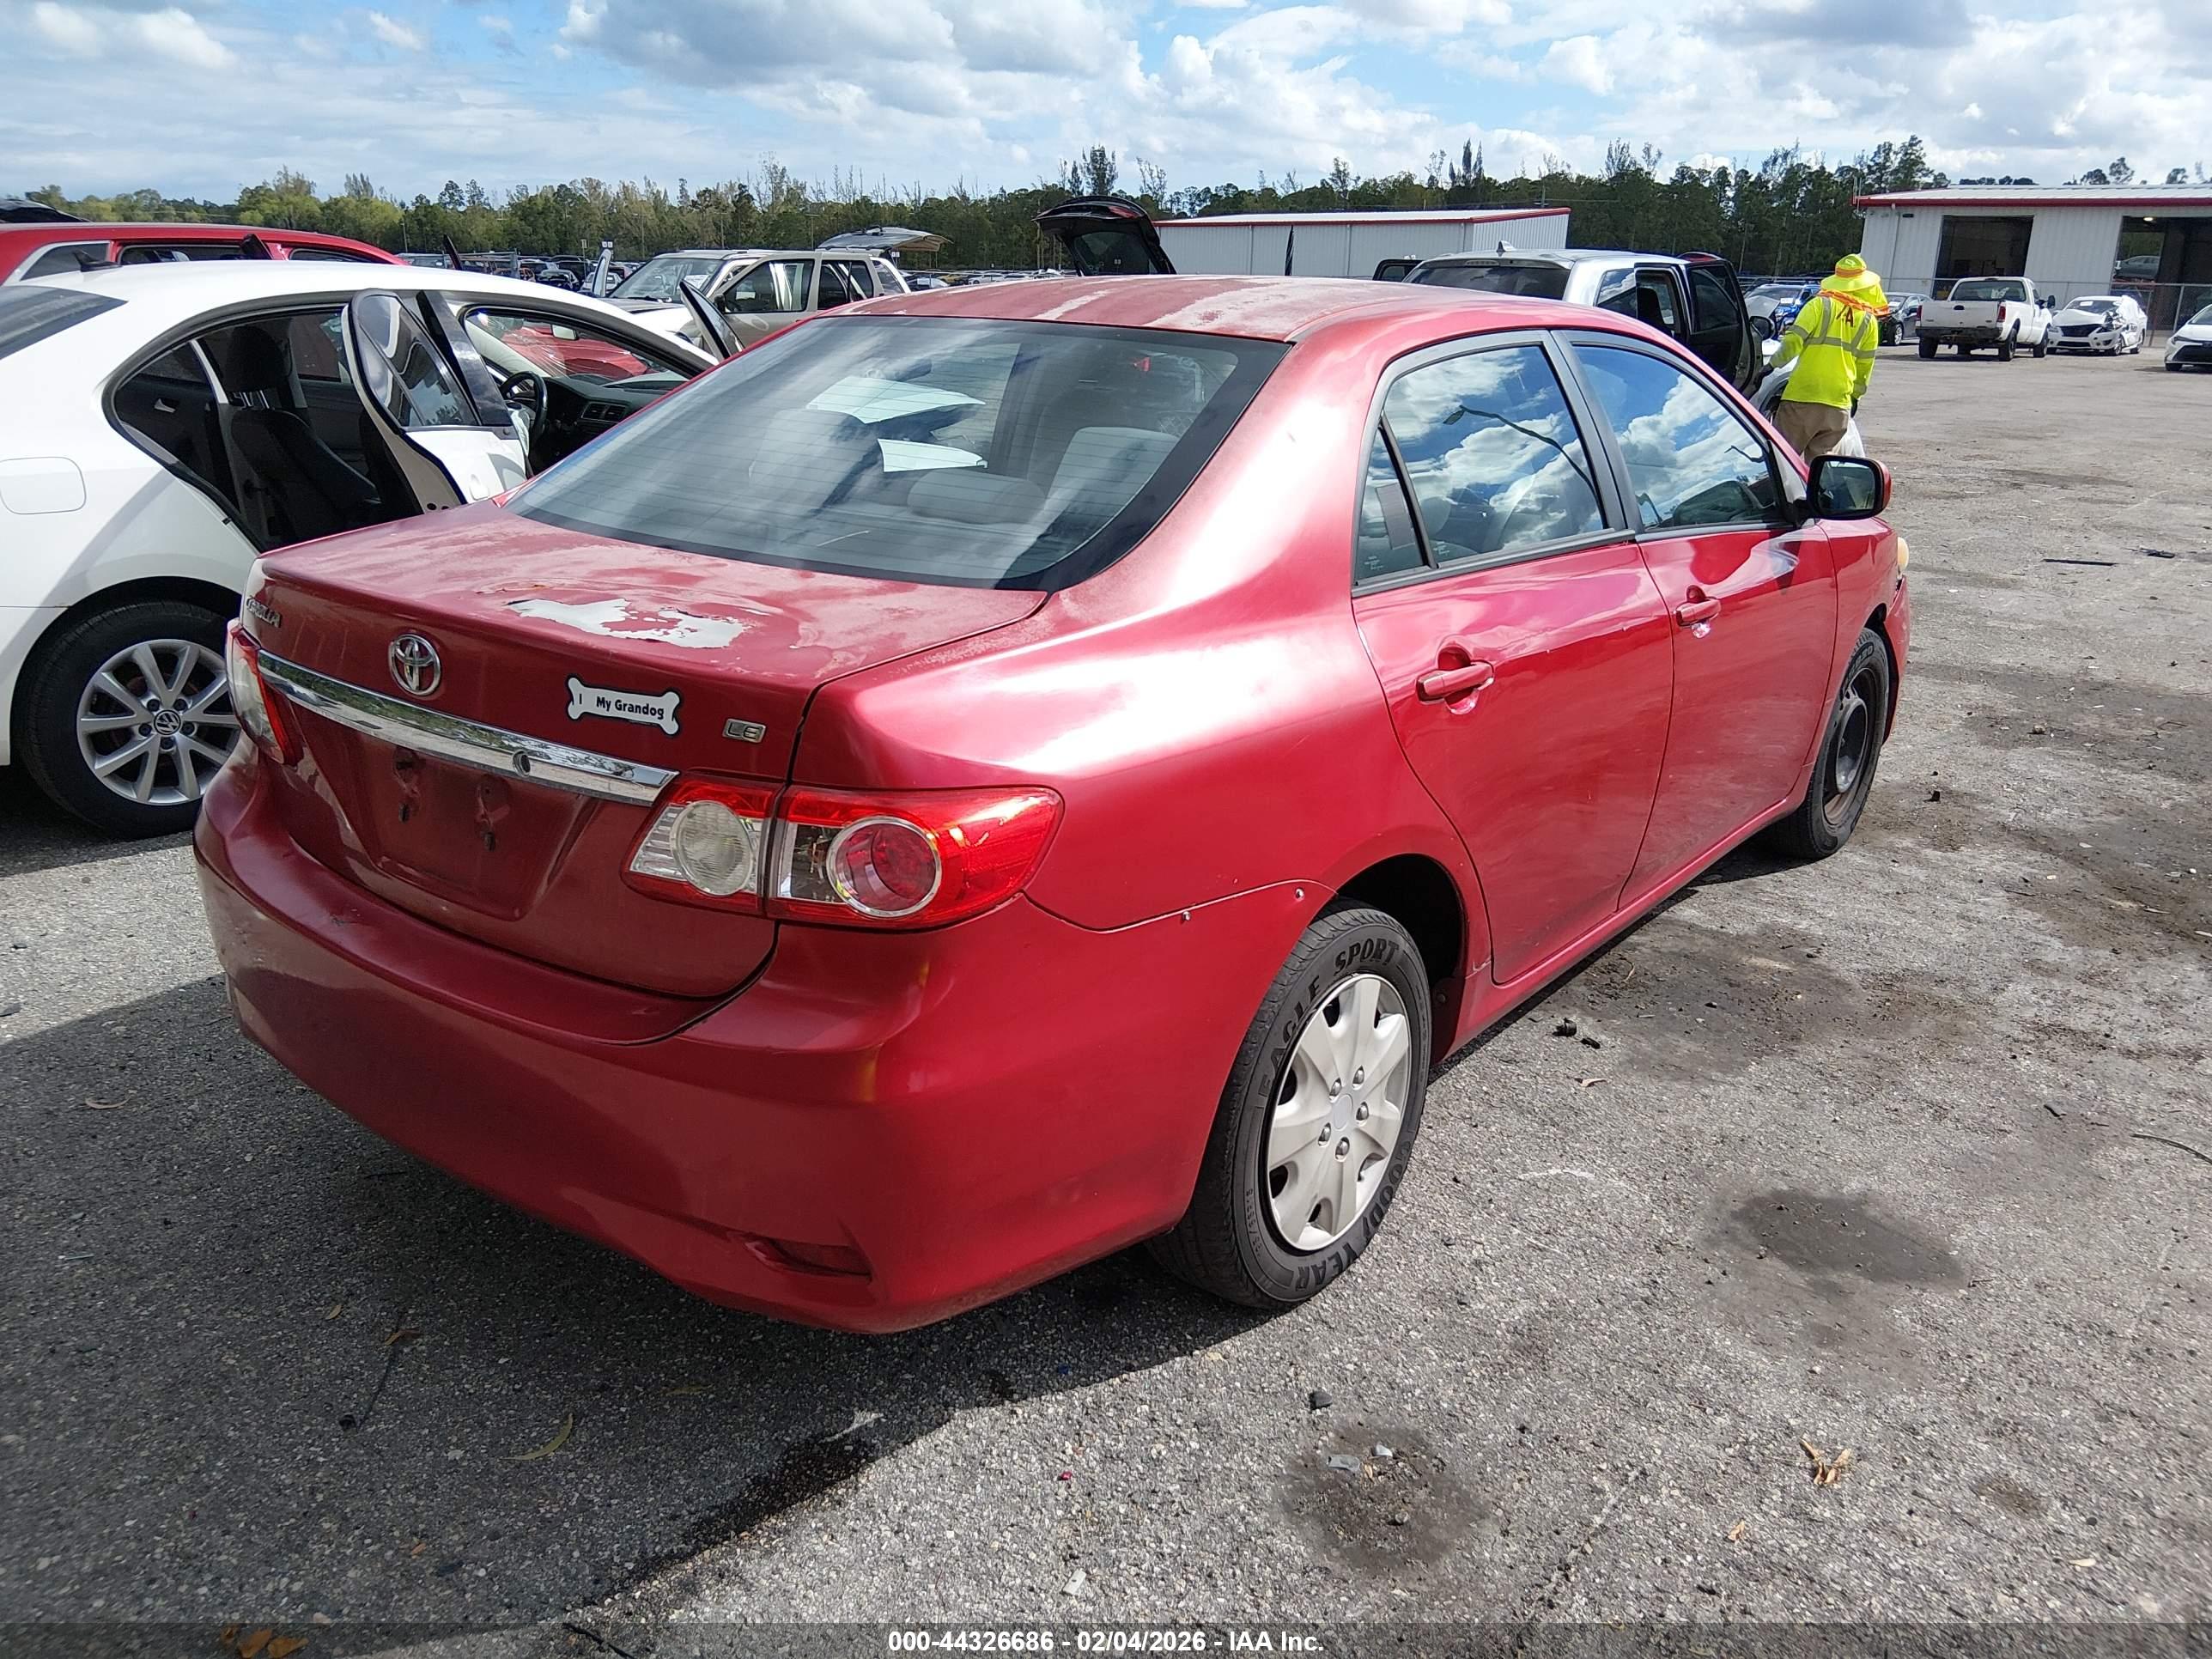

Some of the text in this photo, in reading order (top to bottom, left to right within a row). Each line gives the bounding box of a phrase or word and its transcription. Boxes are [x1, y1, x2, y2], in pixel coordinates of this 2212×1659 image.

[596, 695, 611, 712] My
[614, 698, 665, 720] Grandog
[726, 720, 762, 740] LE
[1257, 938, 1400, 1098] EAGLE SPORT
